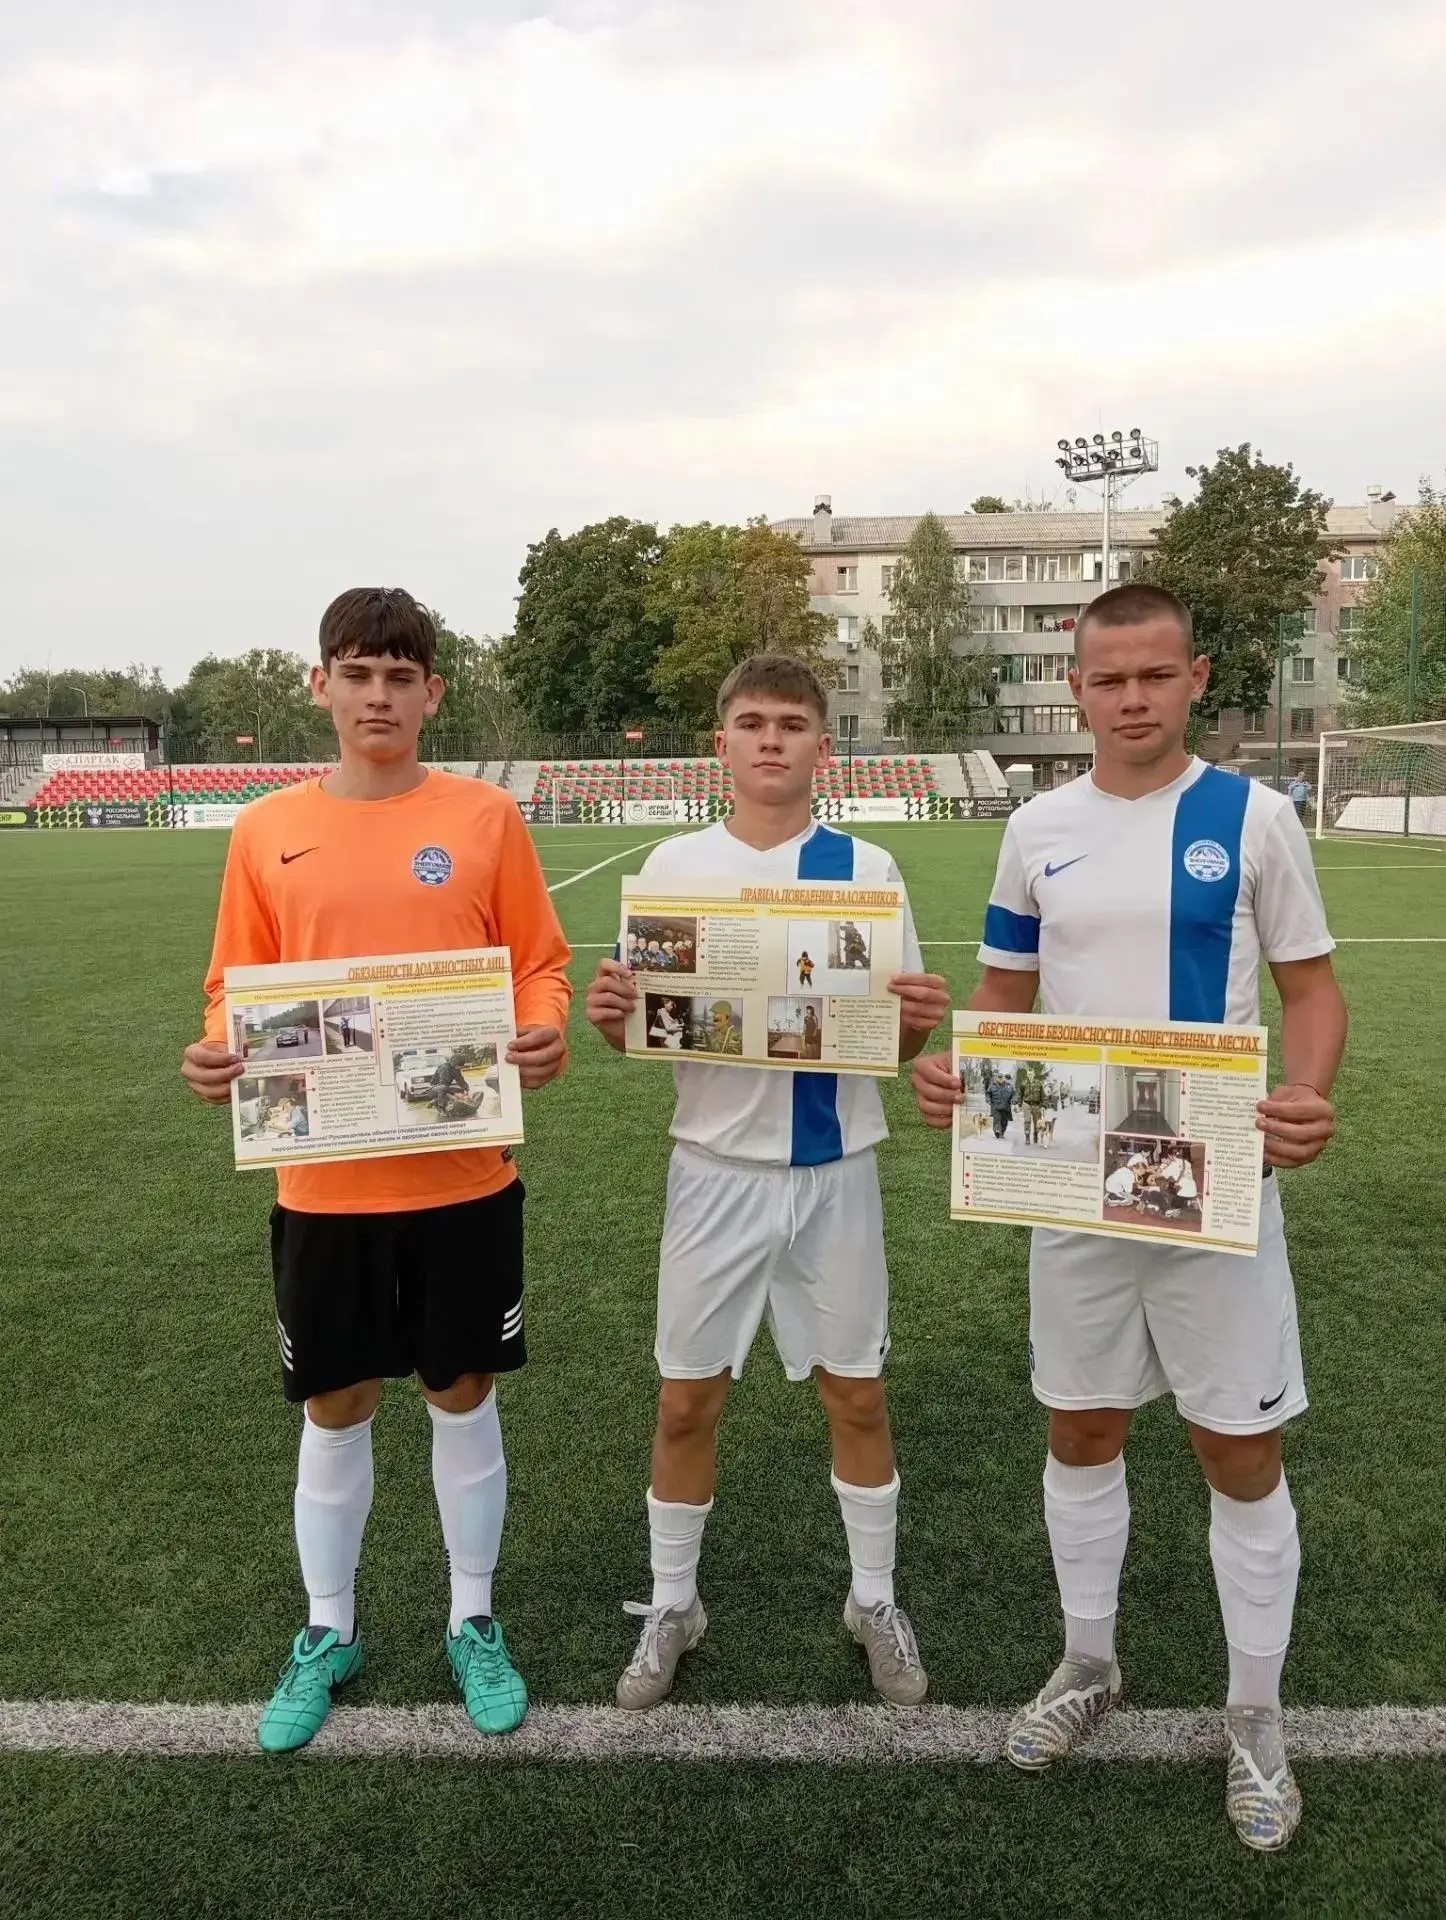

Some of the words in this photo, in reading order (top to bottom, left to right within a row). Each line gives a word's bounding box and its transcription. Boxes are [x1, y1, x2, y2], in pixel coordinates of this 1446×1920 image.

[67, 755, 120, 764] СПАРТАК
[740, 888, 781, 903] ПРАВИЛА
[781, 888, 834, 906] ПОВЕДЕНИЯ
[835, 889, 898, 906] ЗАЛОЖНИКОВ
[348, 962, 414, 981] ОБЯЗАННОСТИ
[415, 958, 485, 977] ДОЛЖНОСТНЫХ
[486, 956, 505, 972] ЛИЦ
[978, 1021, 1045, 1039] ОБЕСПЕЧЕНИЕ
[1046, 1025, 1123, 1044] БЕЗОПАСНОСТИ
[1125, 1029, 1131, 1043] В
[1132, 1029, 1217, 1049] ОБЩЕСТВЕННЫХ
[1217, 1034, 1260, 1052] МЕСТАХ
